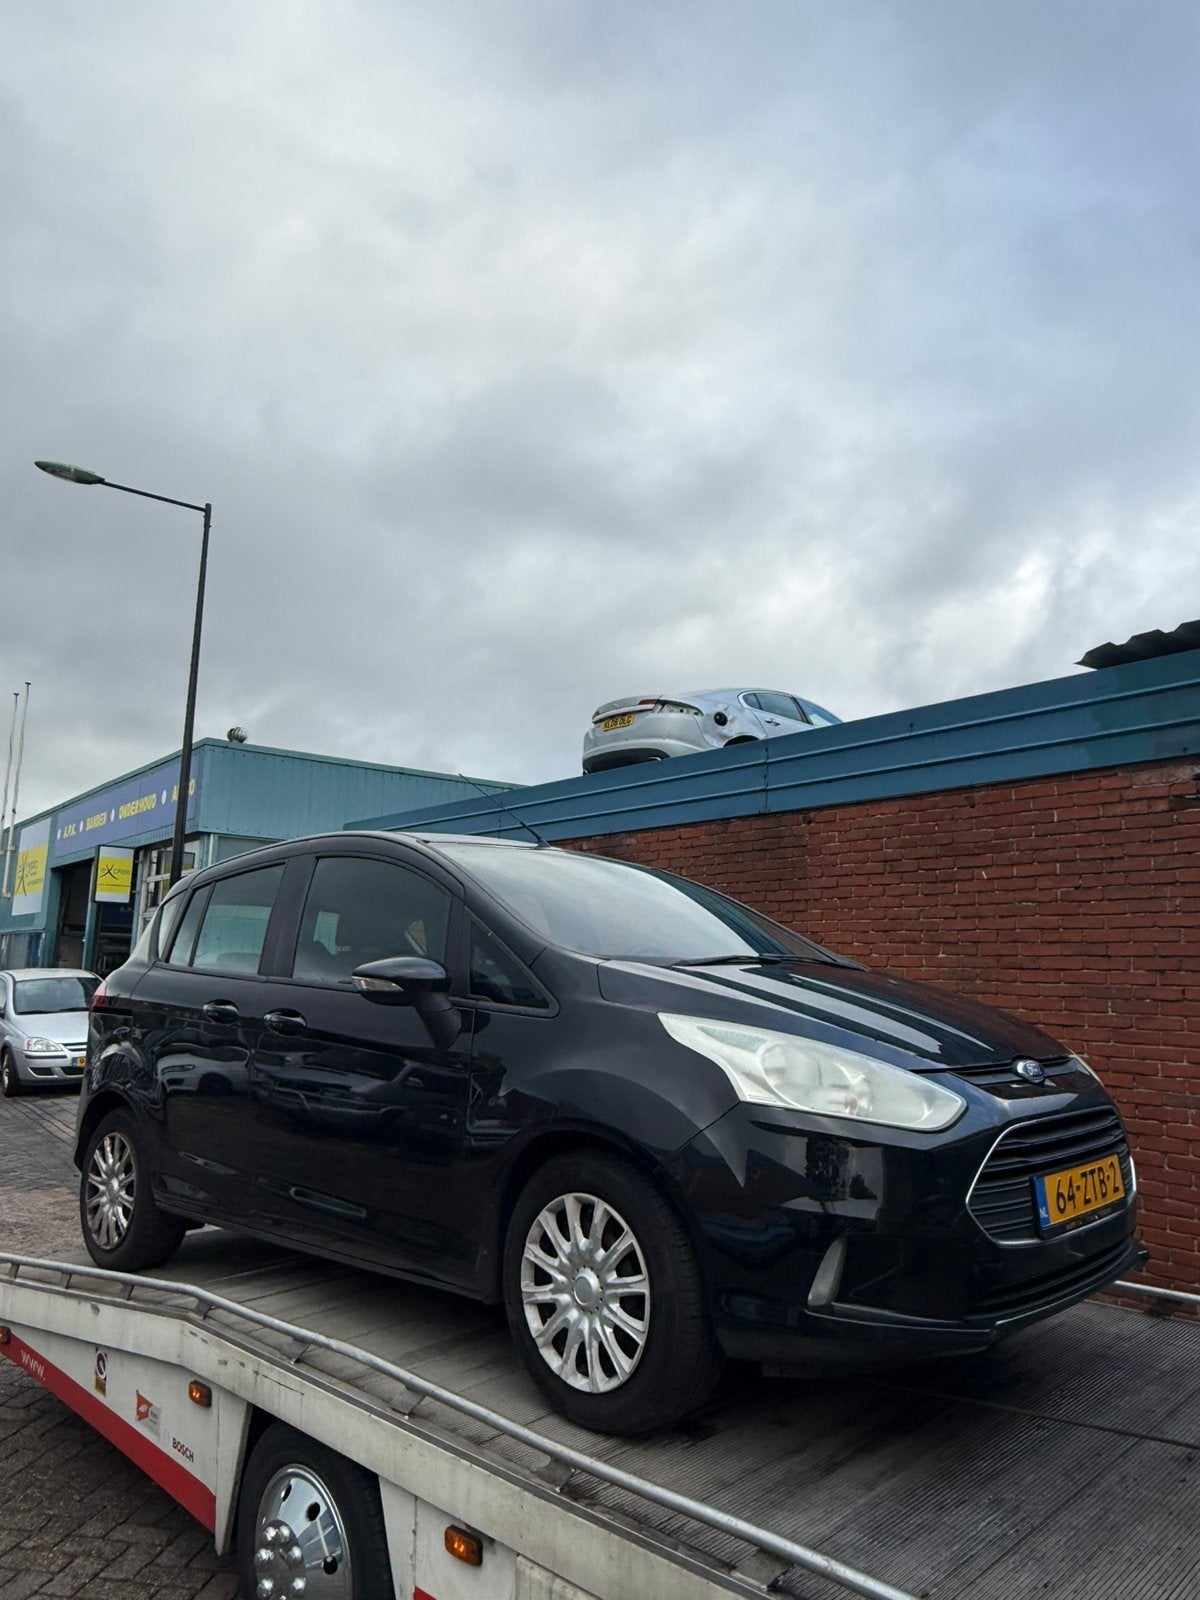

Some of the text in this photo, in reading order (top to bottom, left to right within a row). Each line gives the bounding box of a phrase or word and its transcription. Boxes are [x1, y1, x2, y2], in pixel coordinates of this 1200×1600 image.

[85, 811, 107, 832] BANDEN
[118, 793, 157, 820] ONDERHOUD
[1055, 1160, 1120, 1215] 64-ZTB-2
[172, 1437, 194, 1463] BOSCH
